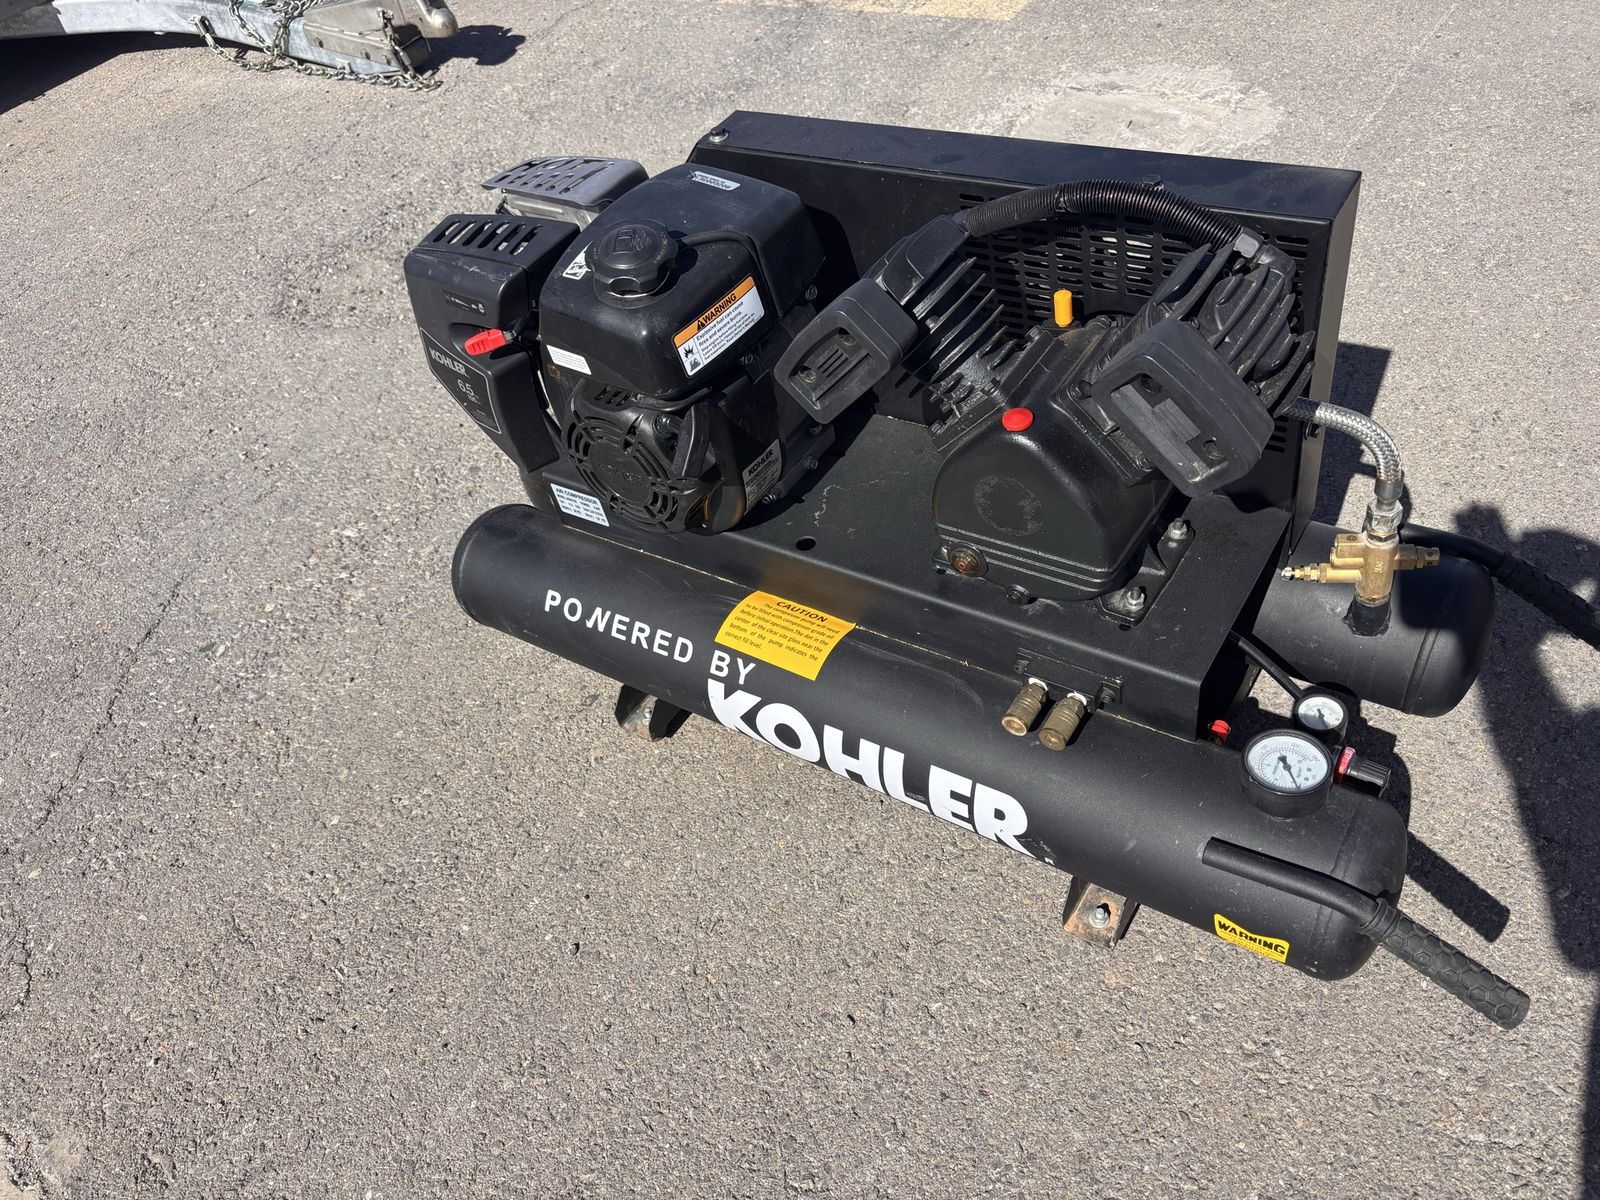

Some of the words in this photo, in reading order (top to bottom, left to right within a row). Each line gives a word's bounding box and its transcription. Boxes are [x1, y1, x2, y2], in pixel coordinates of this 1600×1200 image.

[696, 322, 716, 341] Explosive
[731, 300, 743, 312] cause
[702, 293, 737, 324] WARNING
[698, 336, 708, 347] fires
[708, 330, 716, 339] and
[717, 320, 729, 332] severe
[429, 347, 468, 378] KOHLER
[748, 449, 774, 477] KOHLER
[740, 608, 756, 618] before
[756, 615, 771, 624] initial
[759, 607, 772, 615] filled
[783, 617, 812, 630] compressor
[811, 629, 826, 637] grade
[773, 607, 801, 619] compressor
[801, 616, 816, 625] pump
[776, 601, 828, 622] CAUTION
[544, 589, 693, 664] POWERED
[709, 650, 757, 684] BY
[724, 631, 742, 641] correct
[748, 639, 762, 650] level.
[729, 622, 748, 633] bottom
[767, 639, 784, 649] pump
[785, 643, 807, 657] indicates
[734, 616, 751, 625] center
[766, 628, 779, 636] clear
[787, 636, 801, 645] glass
[707, 678, 1038, 859] KOHLER
[1218, 920, 1286, 955] WARNING
